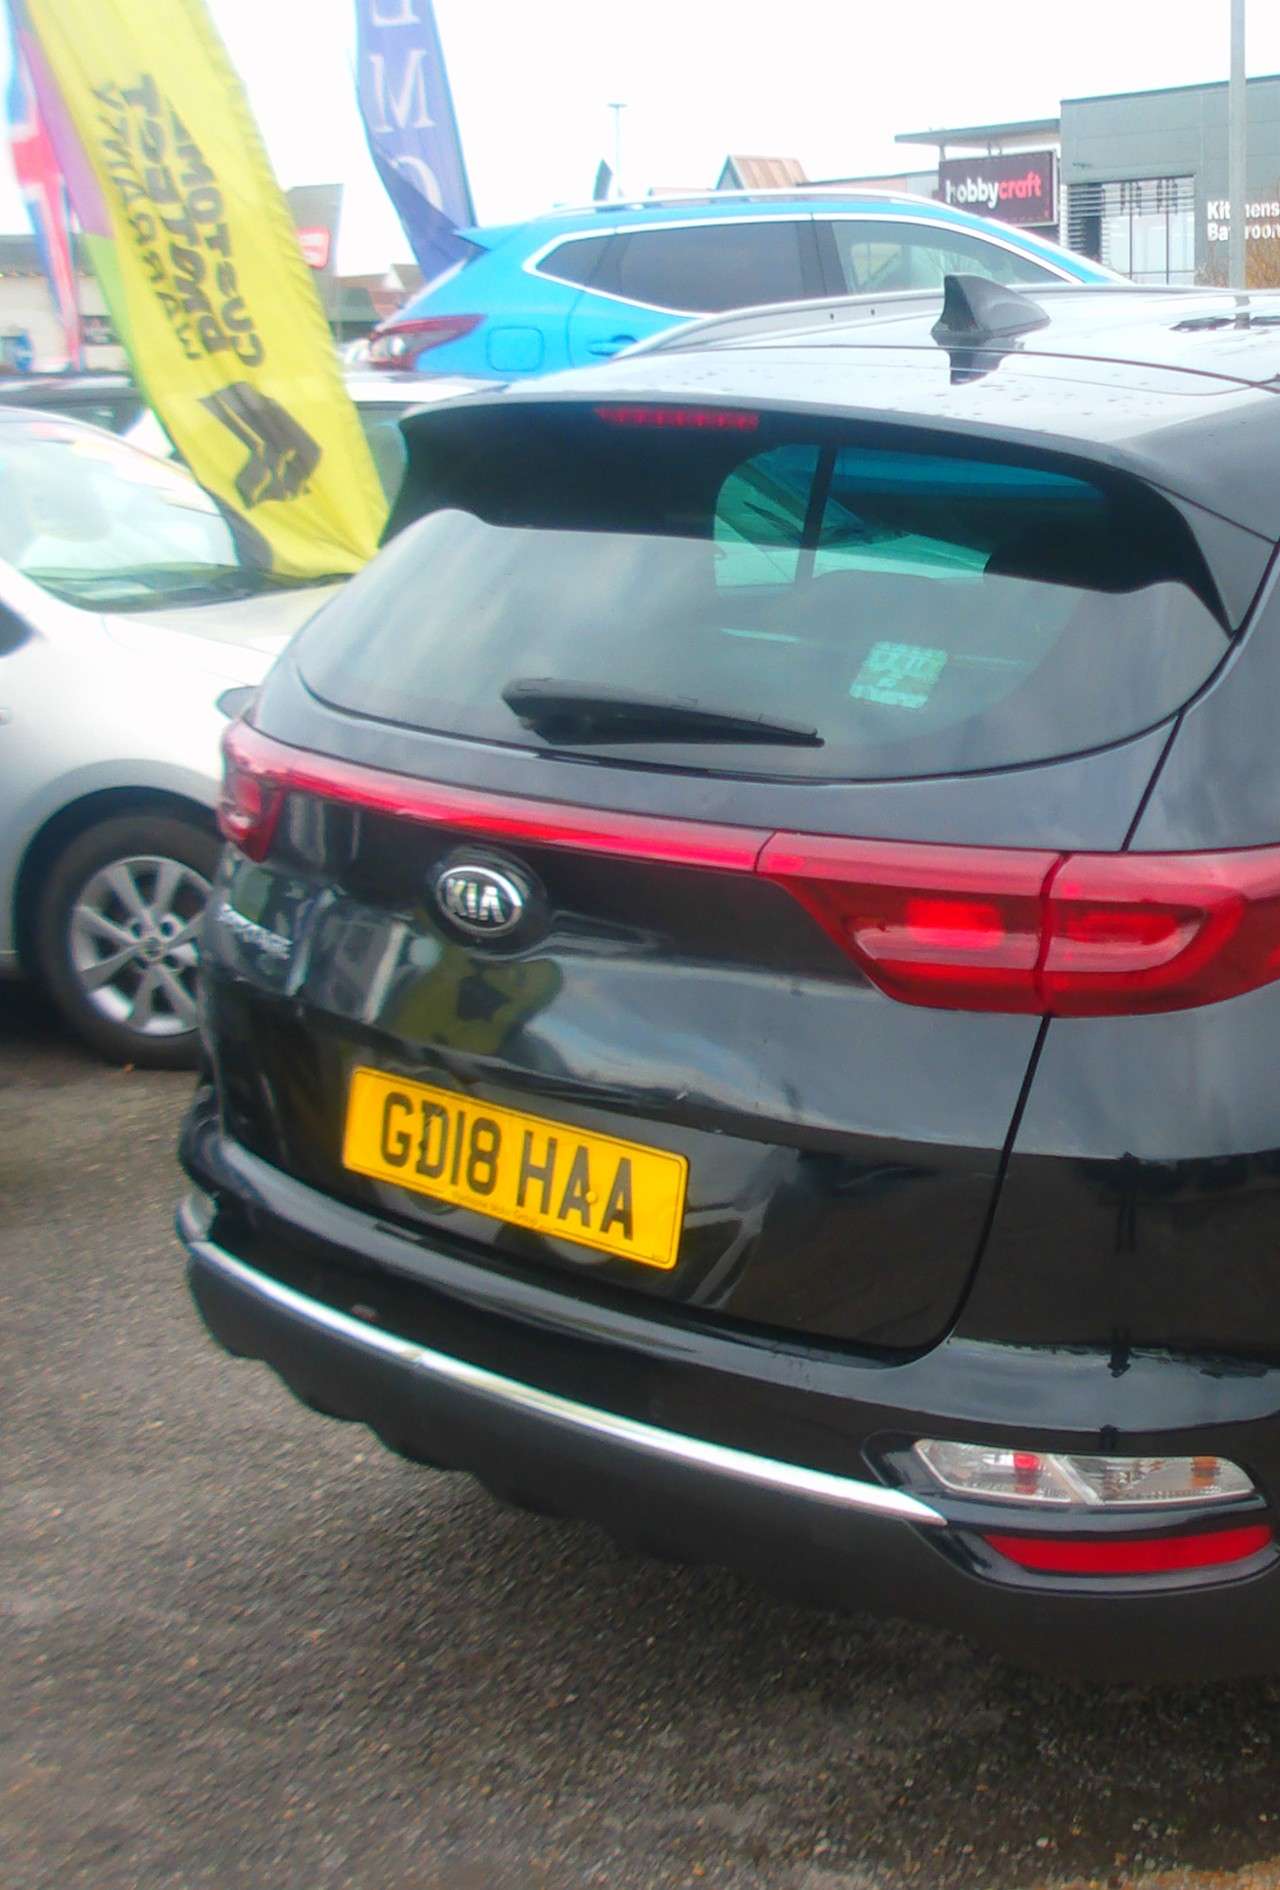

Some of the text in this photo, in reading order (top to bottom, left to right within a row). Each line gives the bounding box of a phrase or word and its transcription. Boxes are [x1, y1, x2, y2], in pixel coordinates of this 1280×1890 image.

[945, 171, 1042, 209] hobbycraft
[446, 879, 505, 923] KIA
[380, 1092, 634, 1241] GD18 HAA
